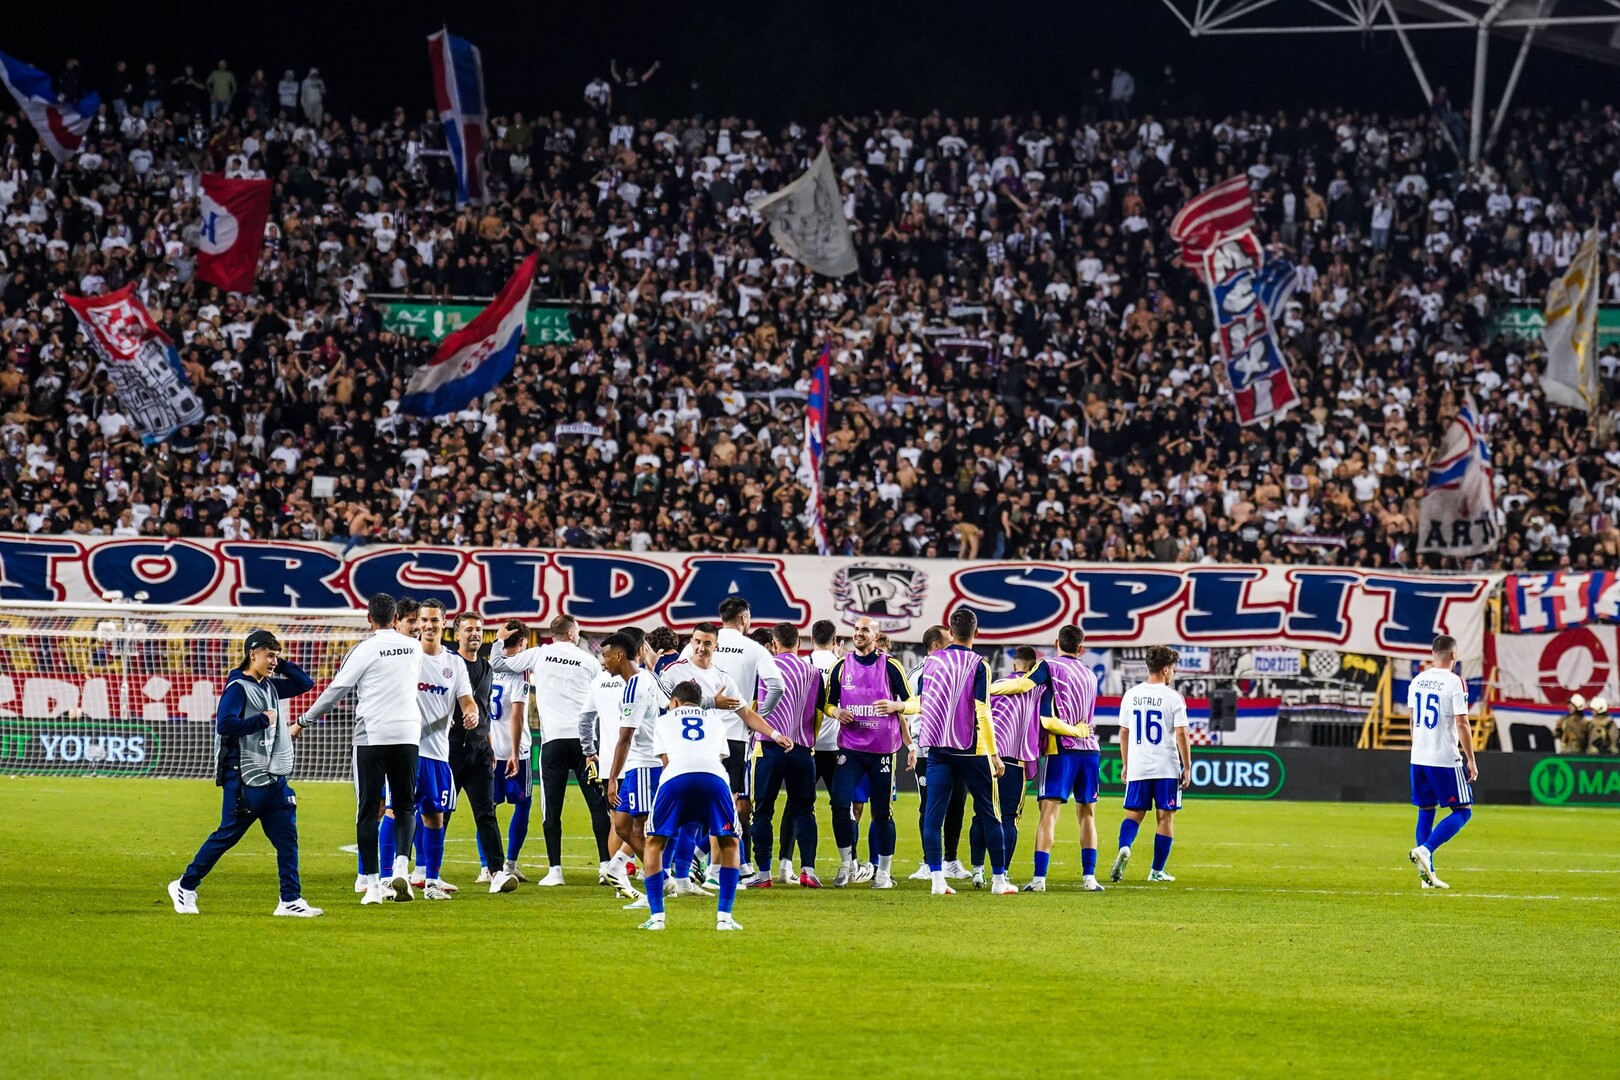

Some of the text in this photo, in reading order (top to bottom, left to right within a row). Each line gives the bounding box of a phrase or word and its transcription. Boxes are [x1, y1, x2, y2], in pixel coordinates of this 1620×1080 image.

[0, 534, 1490, 654] TORCIDA SPLIT
[379, 648, 415, 658] HAJDUK
[713, 646, 745, 655] AJDUK
[545, 656, 582, 667] HAJDUK
[417, 682, 449, 695] OMMY
[600, 681, 624, 689] HAJDU
[1415, 692, 1440, 729] 15
[681, 717, 705, 741] 8
[1133, 710, 1163, 745] 16
[39, 734, 146, 763] YOURS
[880, 756, 891, 765] 44
[1190, 759, 1271, 788] OURS
[441, 790, 449, 807] 5
[628, 792, 636, 810] 9
